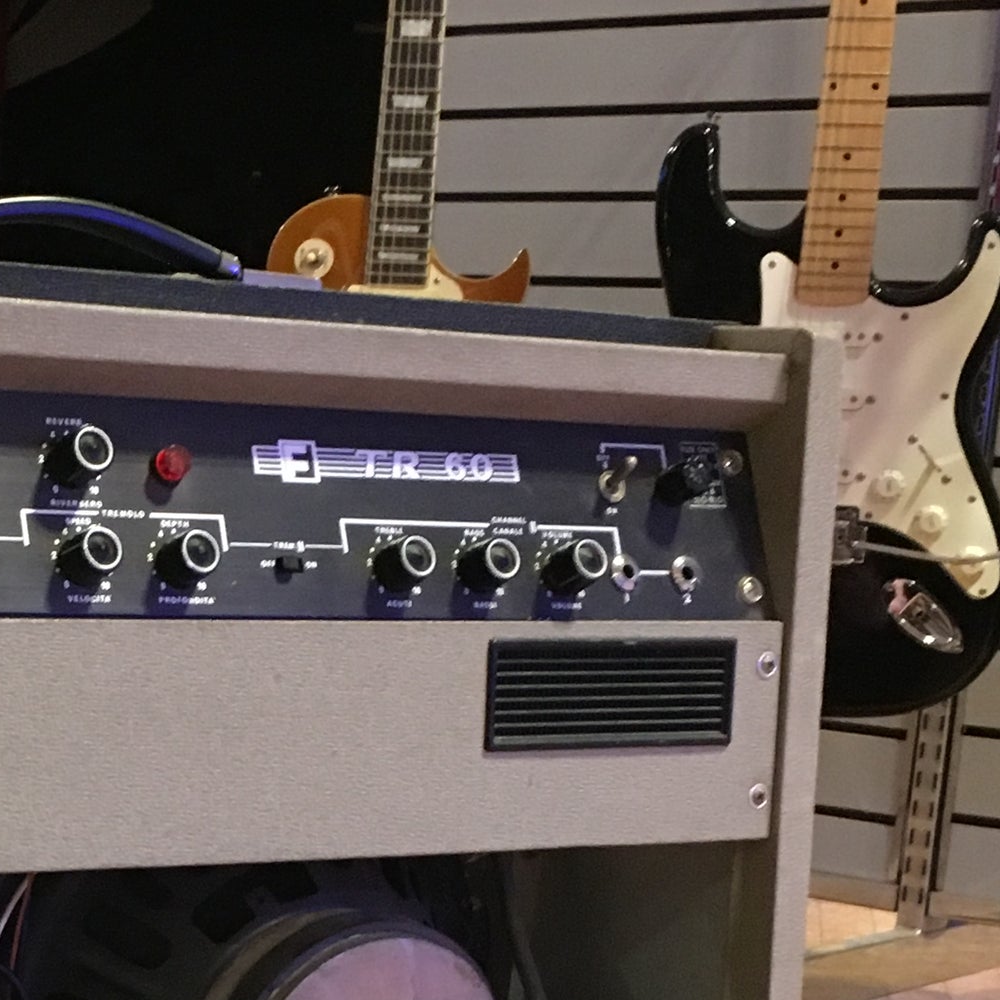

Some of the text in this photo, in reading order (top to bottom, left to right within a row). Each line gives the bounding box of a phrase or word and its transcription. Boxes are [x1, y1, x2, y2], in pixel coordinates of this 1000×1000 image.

[354, 449, 494, 481] TR 60
[101, 509, 146, 519] TREMOLO
[160, 519, 190, 528] DEPTH
[682, 592, 692, 606] 2
